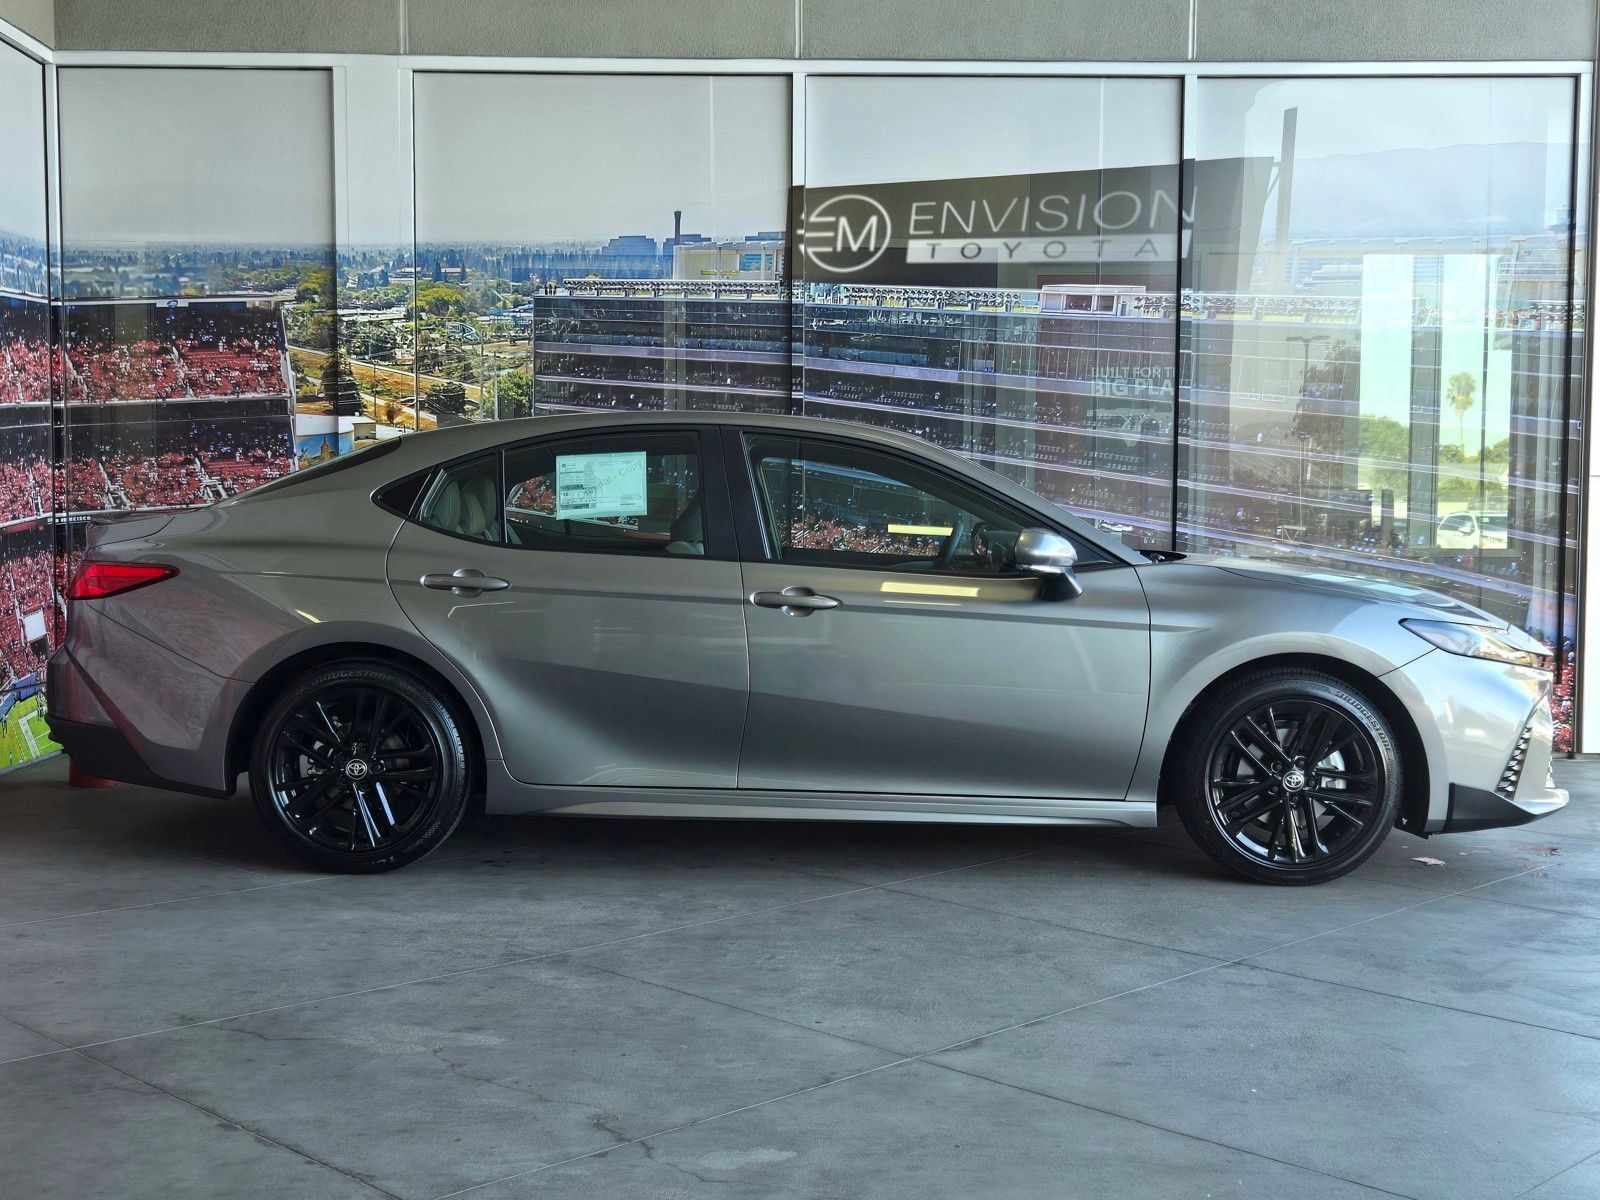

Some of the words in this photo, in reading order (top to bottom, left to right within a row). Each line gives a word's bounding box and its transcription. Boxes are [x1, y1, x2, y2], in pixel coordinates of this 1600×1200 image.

[909, 186, 1198, 235] ENVISION
[926, 237, 1159, 260] TOYOTA
[1091, 366, 1129, 378] BUILT
[1132, 366, 1161, 378] FOR
[1091, 378, 1128, 396] BIG
[1335, 690, 1393, 755] BRIDGESTONE
